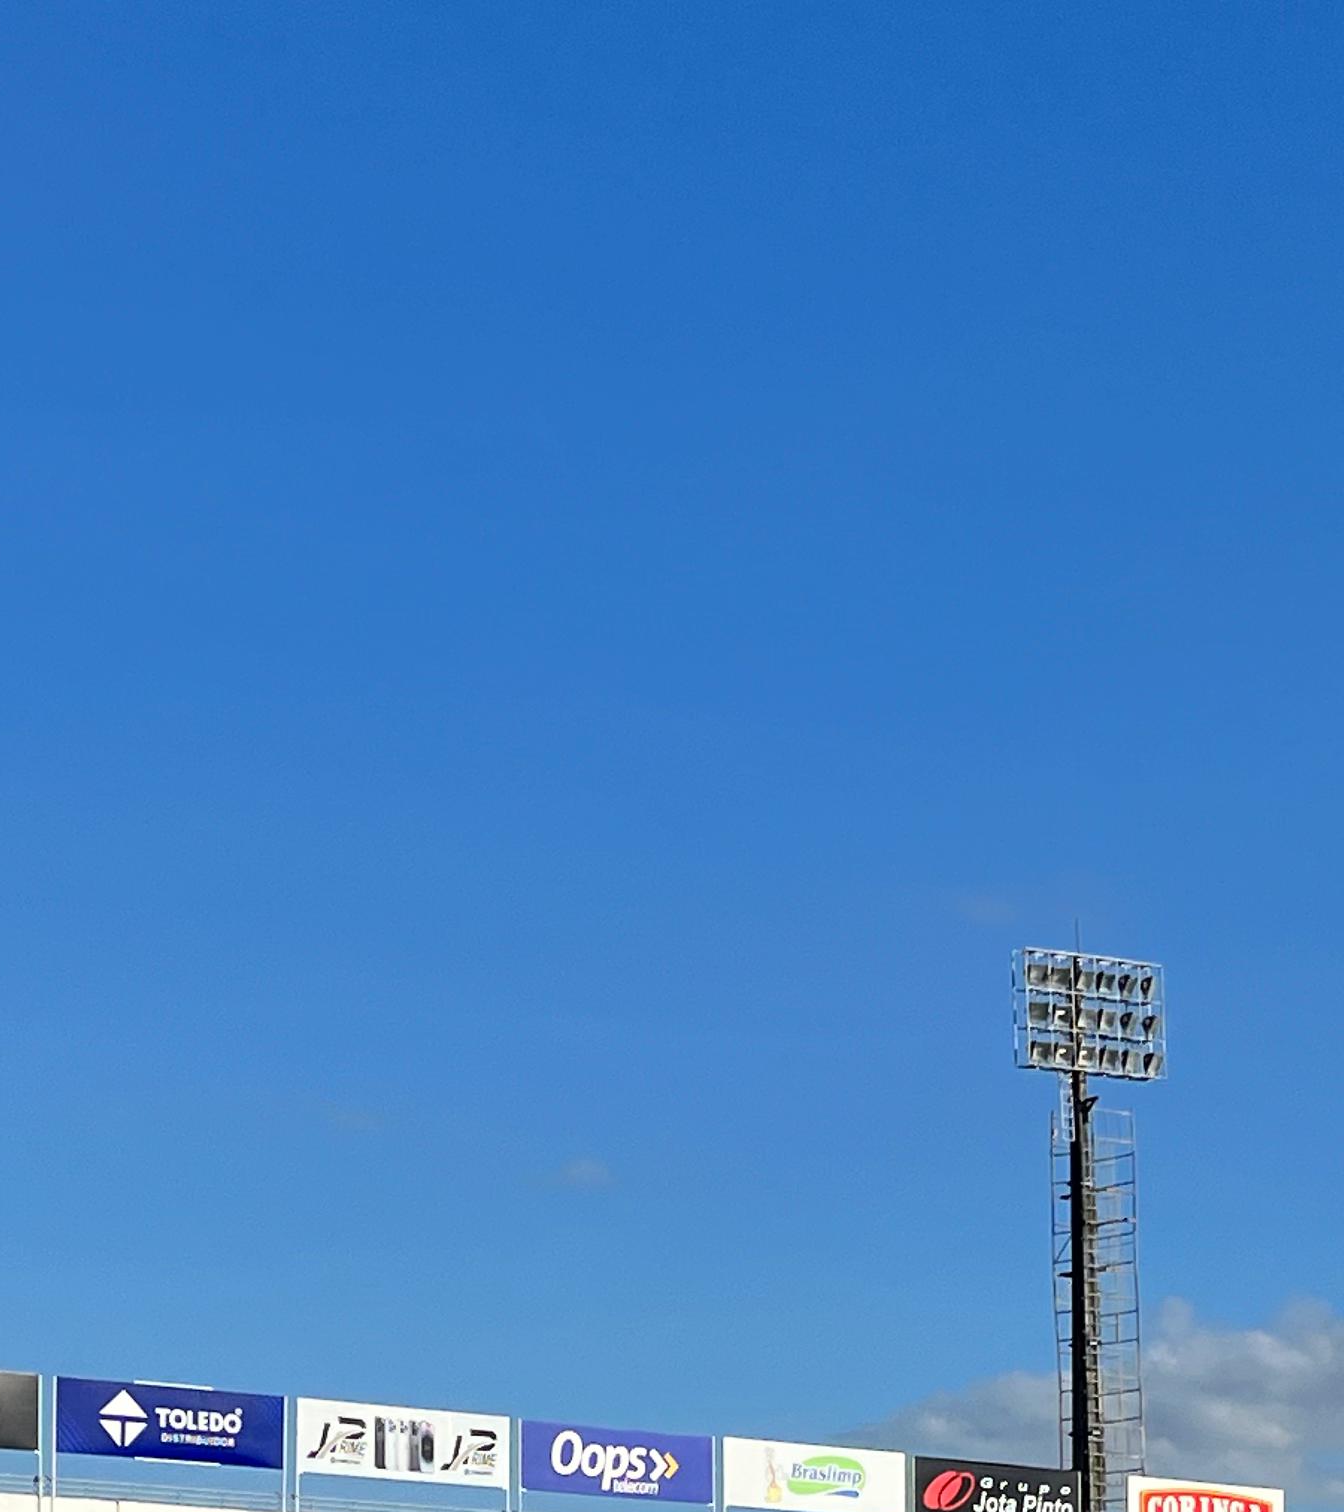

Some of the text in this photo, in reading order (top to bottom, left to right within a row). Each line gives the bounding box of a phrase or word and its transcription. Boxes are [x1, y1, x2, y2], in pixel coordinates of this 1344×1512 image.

[155, 1407, 243, 1434] TOLEDO
[551, 1430, 648, 1491] Oops
[791, 1463, 863, 1487] Braslimp
